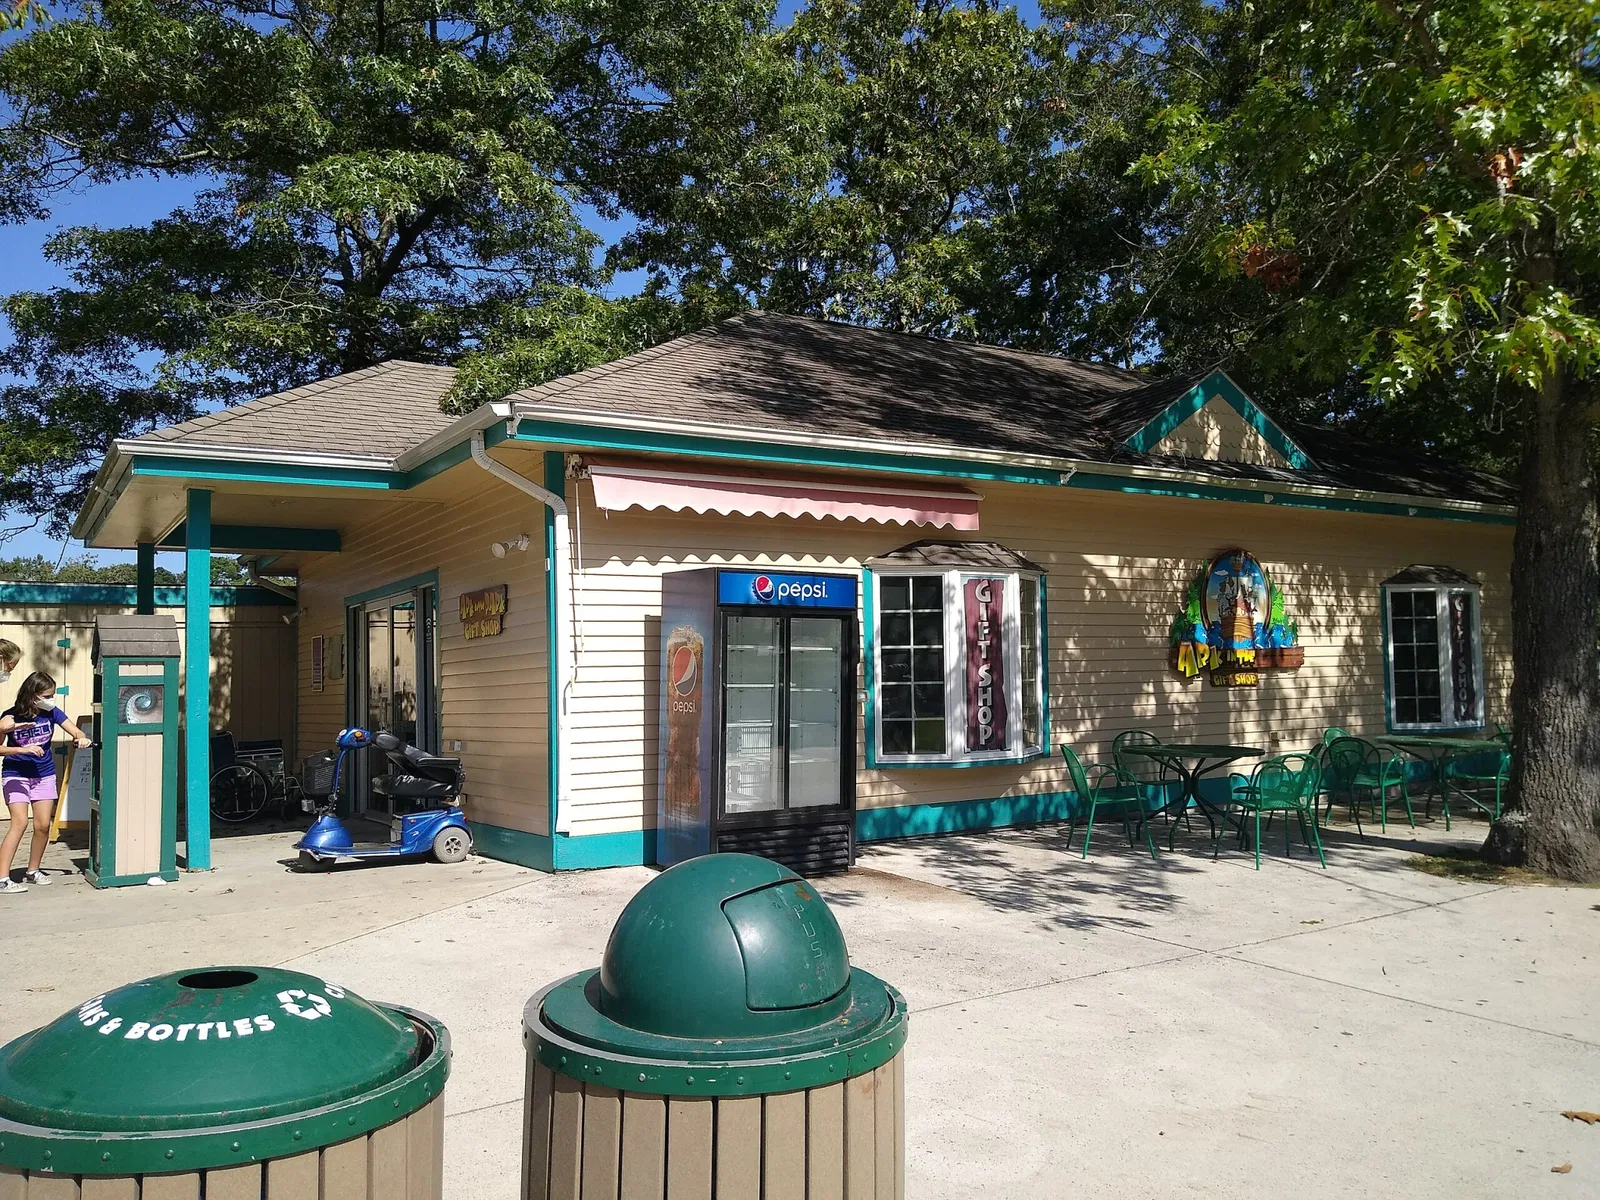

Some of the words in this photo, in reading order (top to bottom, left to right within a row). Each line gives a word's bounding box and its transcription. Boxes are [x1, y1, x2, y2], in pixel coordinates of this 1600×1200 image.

[778, 582, 828, 601] pepsi
[975, 579, 992, 660] GIFT
[1177, 642, 1223, 677] ARK
[1234, 672, 1257, 686] SHOP
[672, 699, 696, 716] pepsi
[977, 661, 994, 746] SHOP
[20, 726, 50, 739] GIRL
[98, 1016, 123, 1036] &
[124, 1014, 276, 1042] BOTTLES
